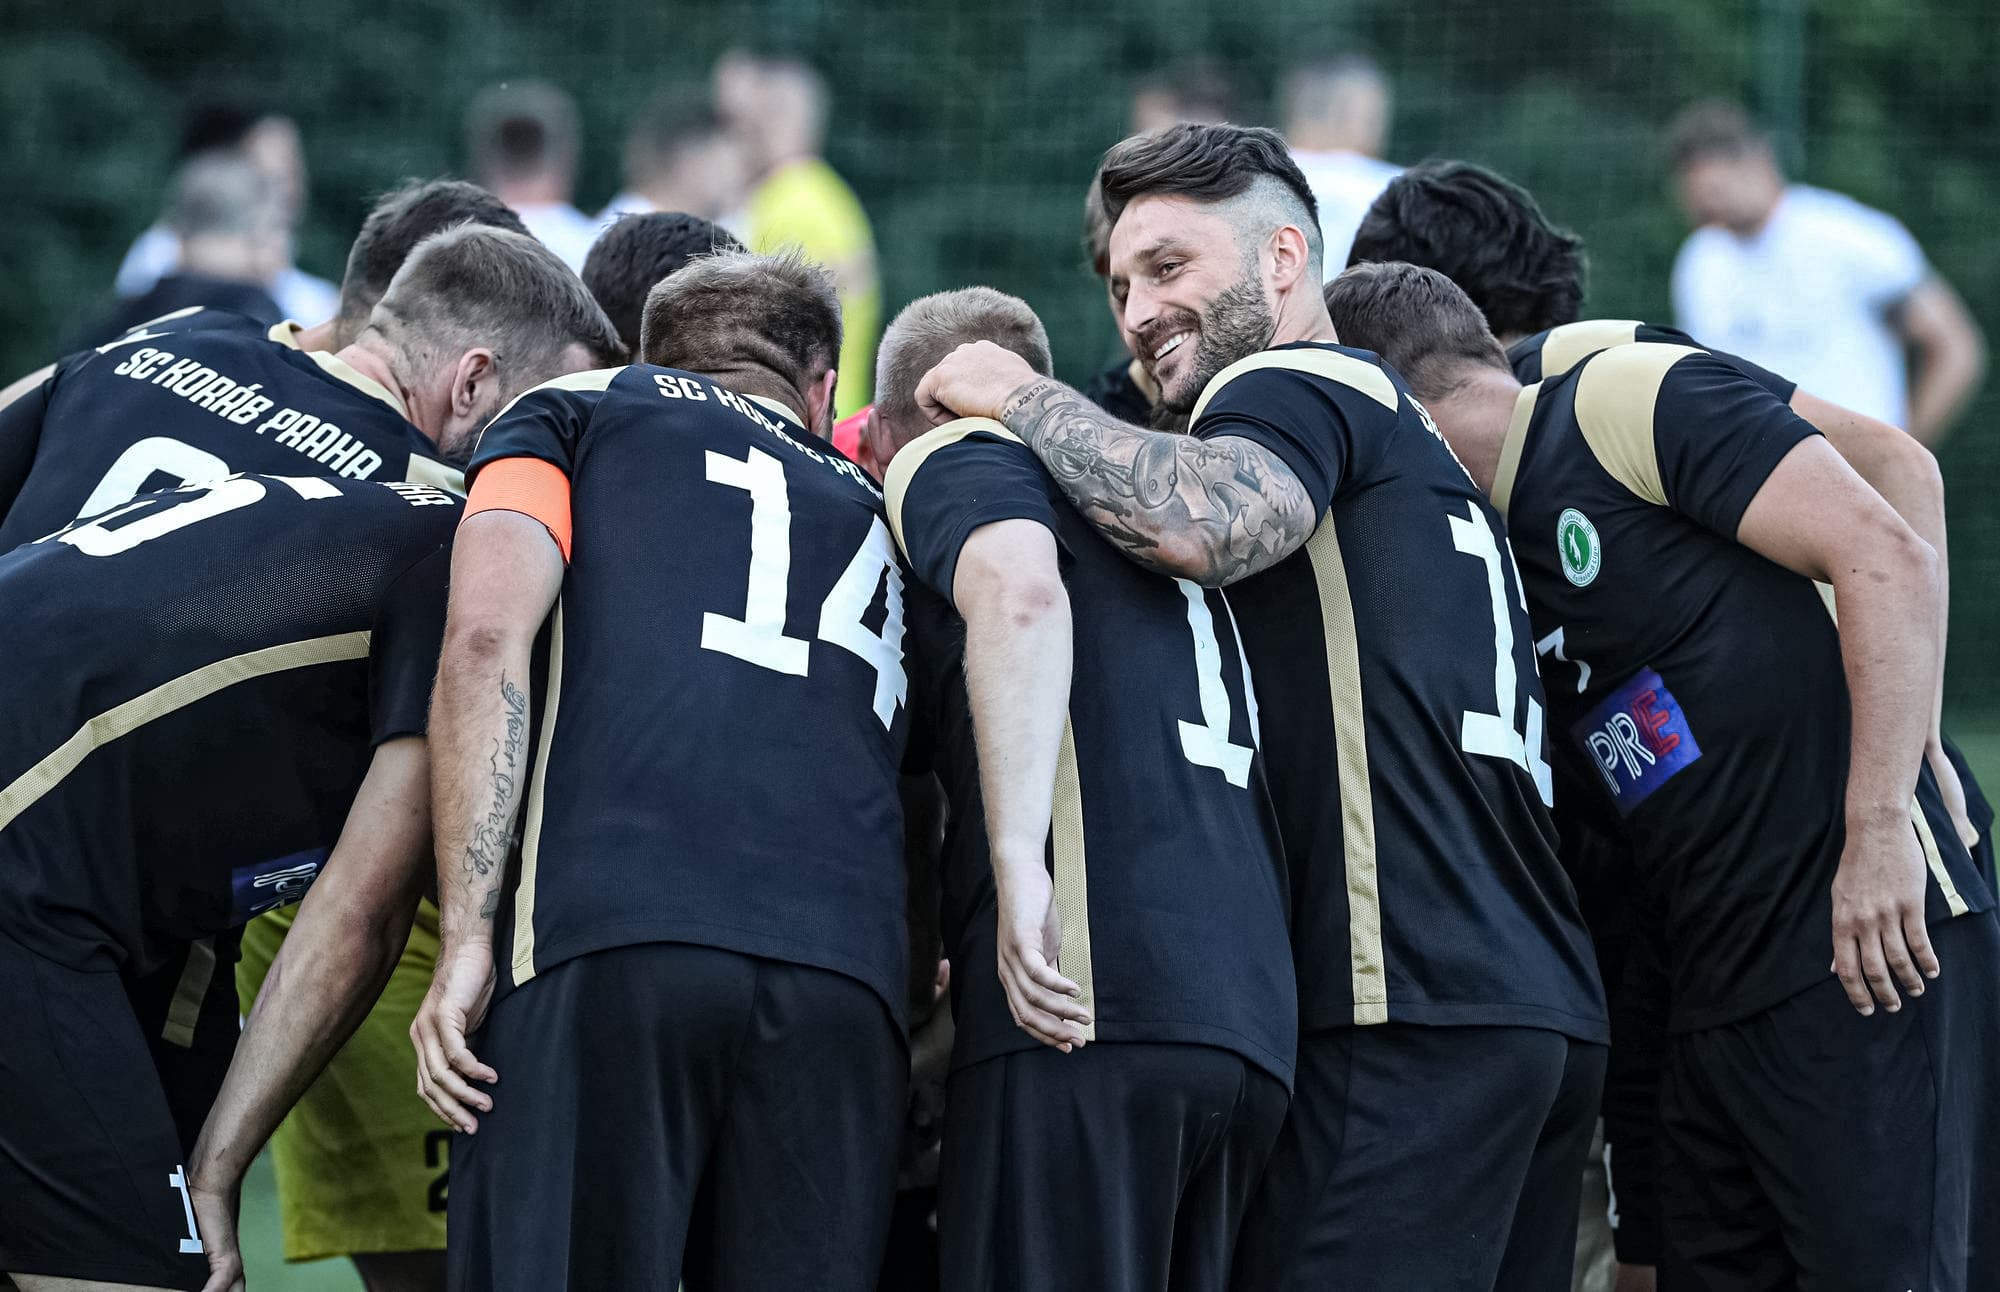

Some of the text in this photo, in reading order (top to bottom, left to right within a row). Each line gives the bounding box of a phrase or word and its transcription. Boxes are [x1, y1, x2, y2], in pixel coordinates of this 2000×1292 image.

[114, 348, 175, 380] SC
[152, 358, 275, 425] KORÁB
[256, 407, 383, 481] PRAHA
[653, 374, 707, 401] SC
[701, 445, 908, 732] 14
[1584, 689, 1681, 797] PRE
